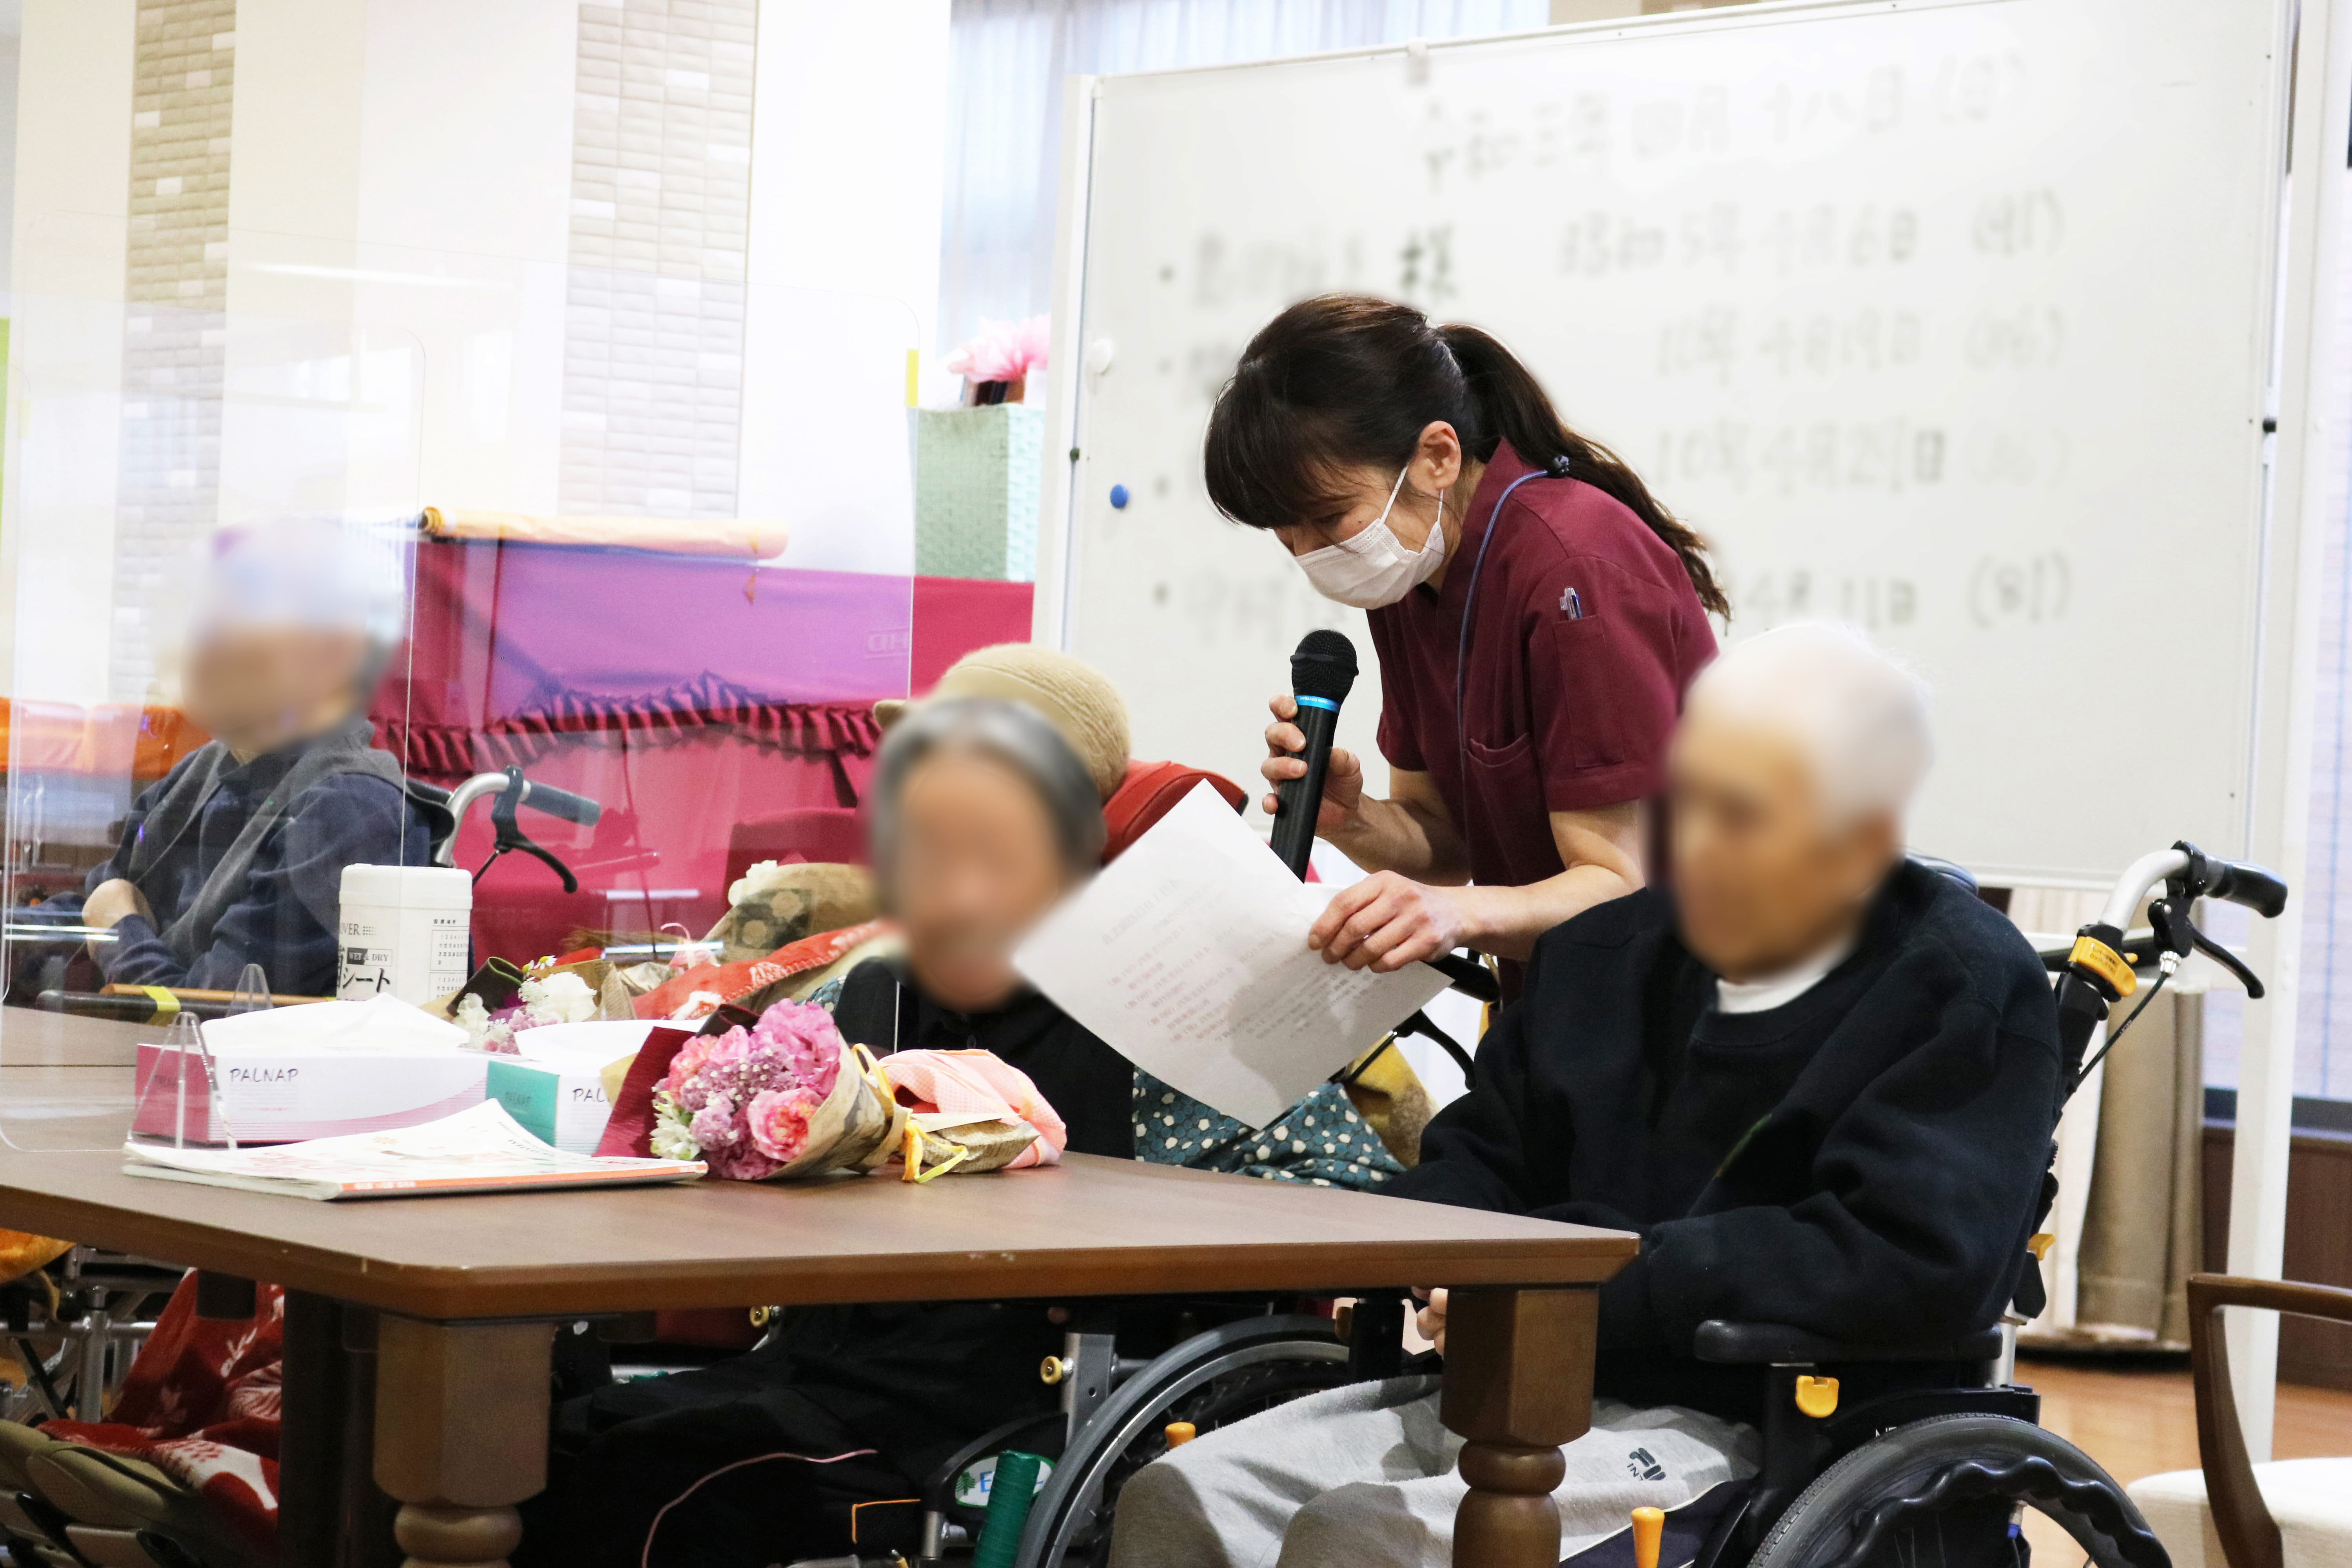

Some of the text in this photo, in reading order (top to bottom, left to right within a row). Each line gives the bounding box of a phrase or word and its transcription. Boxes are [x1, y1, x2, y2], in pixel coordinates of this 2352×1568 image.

[372, 953, 389, 962] DRY
[230, 1067, 298, 1082] PALNAP
[572, 1087, 609, 1102] PAL
